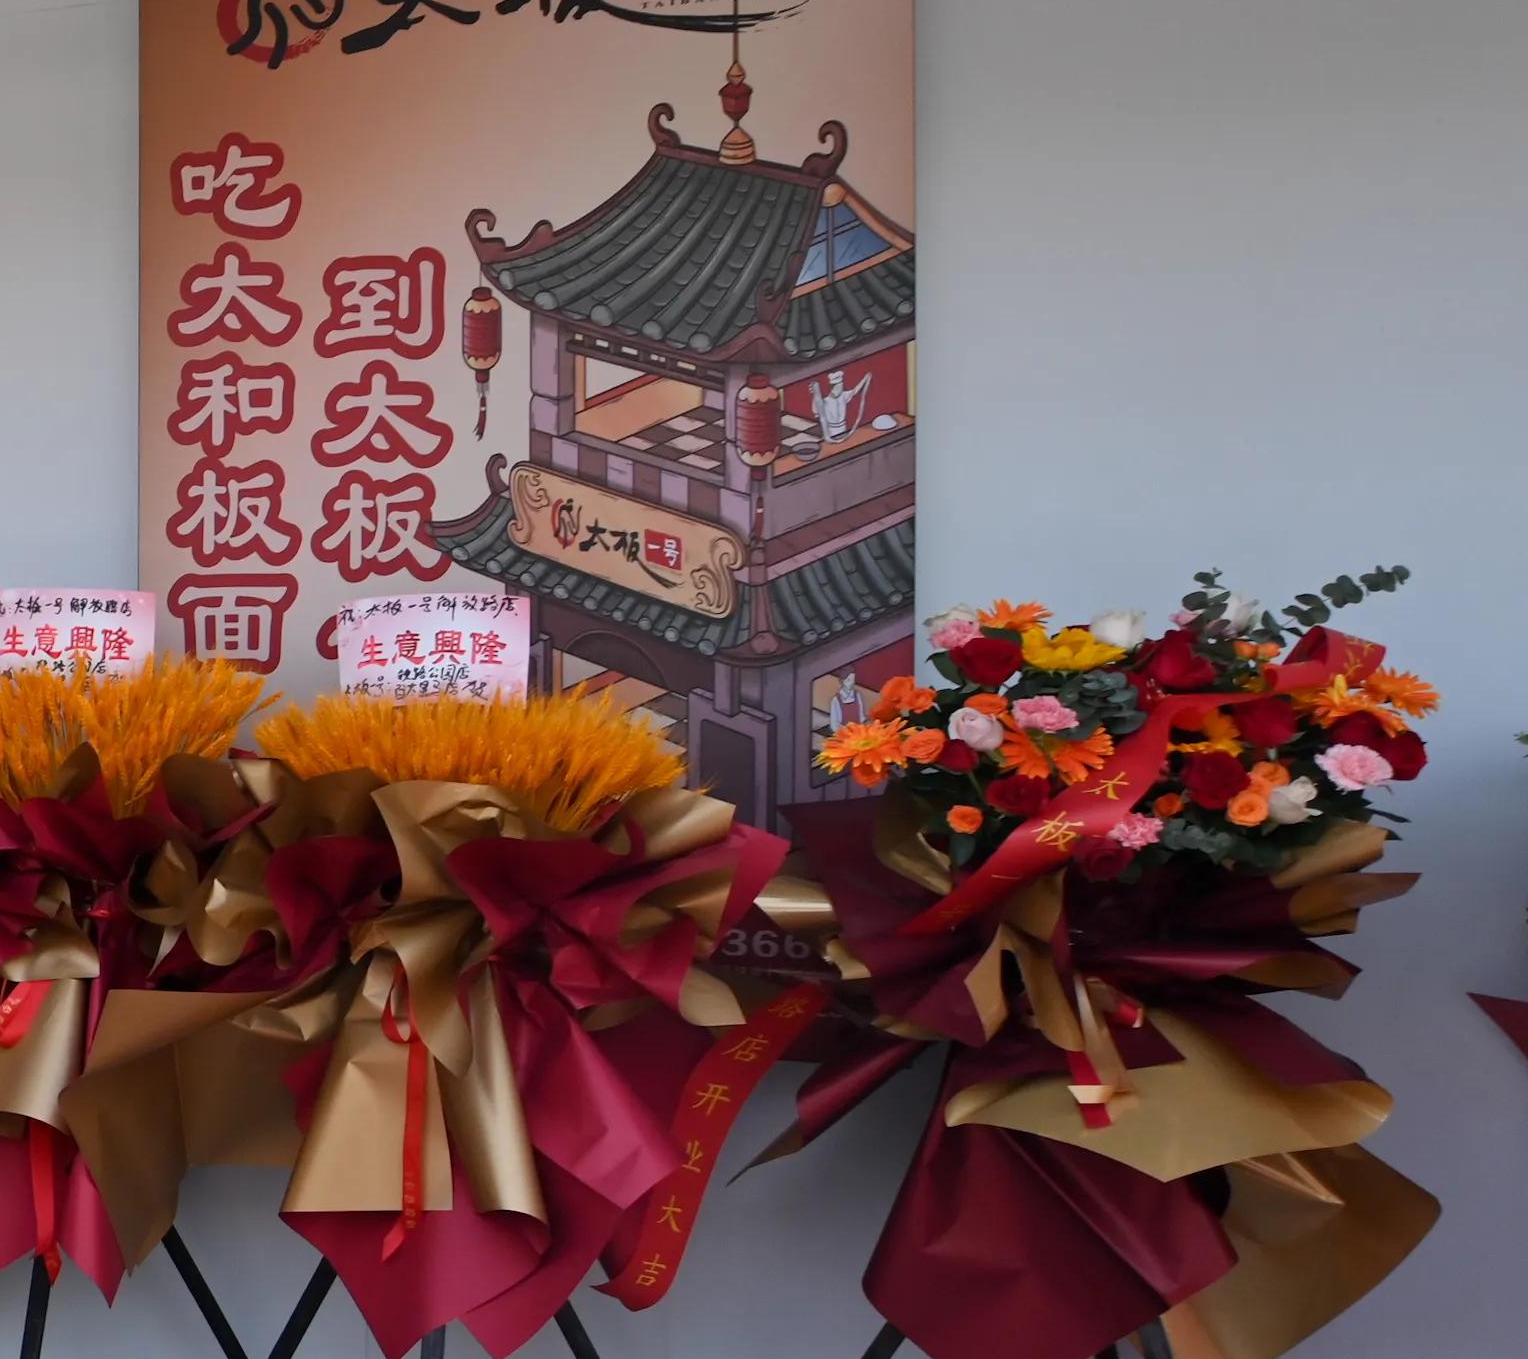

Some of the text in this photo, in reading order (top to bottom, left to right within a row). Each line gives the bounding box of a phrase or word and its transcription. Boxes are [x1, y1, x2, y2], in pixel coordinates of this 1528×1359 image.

[170, 136, 299, 672] 吃太和板面
[316, 250, 446, 607] 到太板
